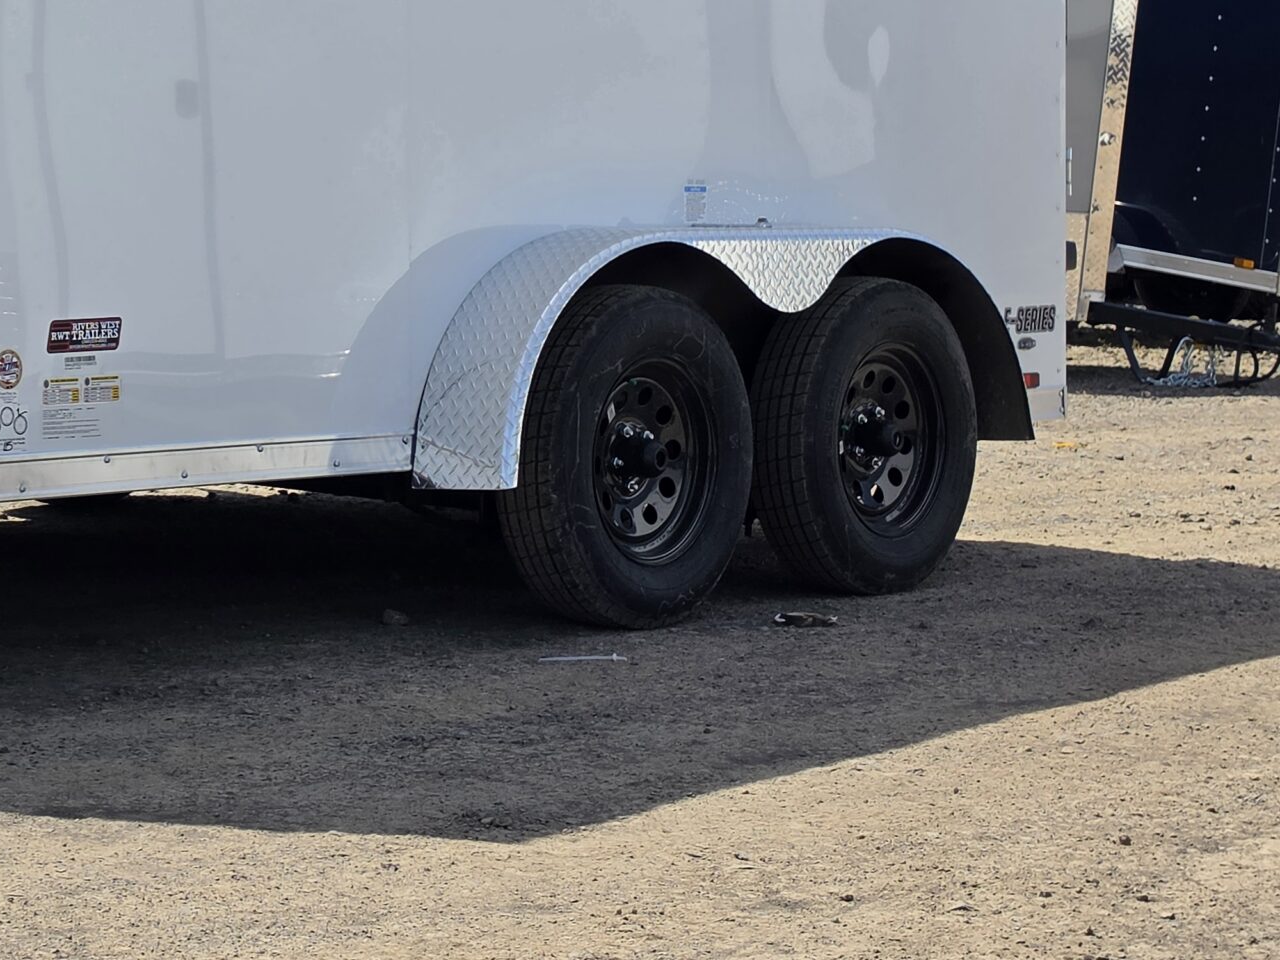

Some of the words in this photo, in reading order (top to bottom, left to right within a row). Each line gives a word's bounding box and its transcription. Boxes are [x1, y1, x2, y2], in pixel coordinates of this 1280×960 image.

[72, 321, 99, 331] RIVERS
[100, 320, 120, 329] WEST
[51, 331, 70, 341] RWT
[71, 328, 119, 341] TRAILERS
